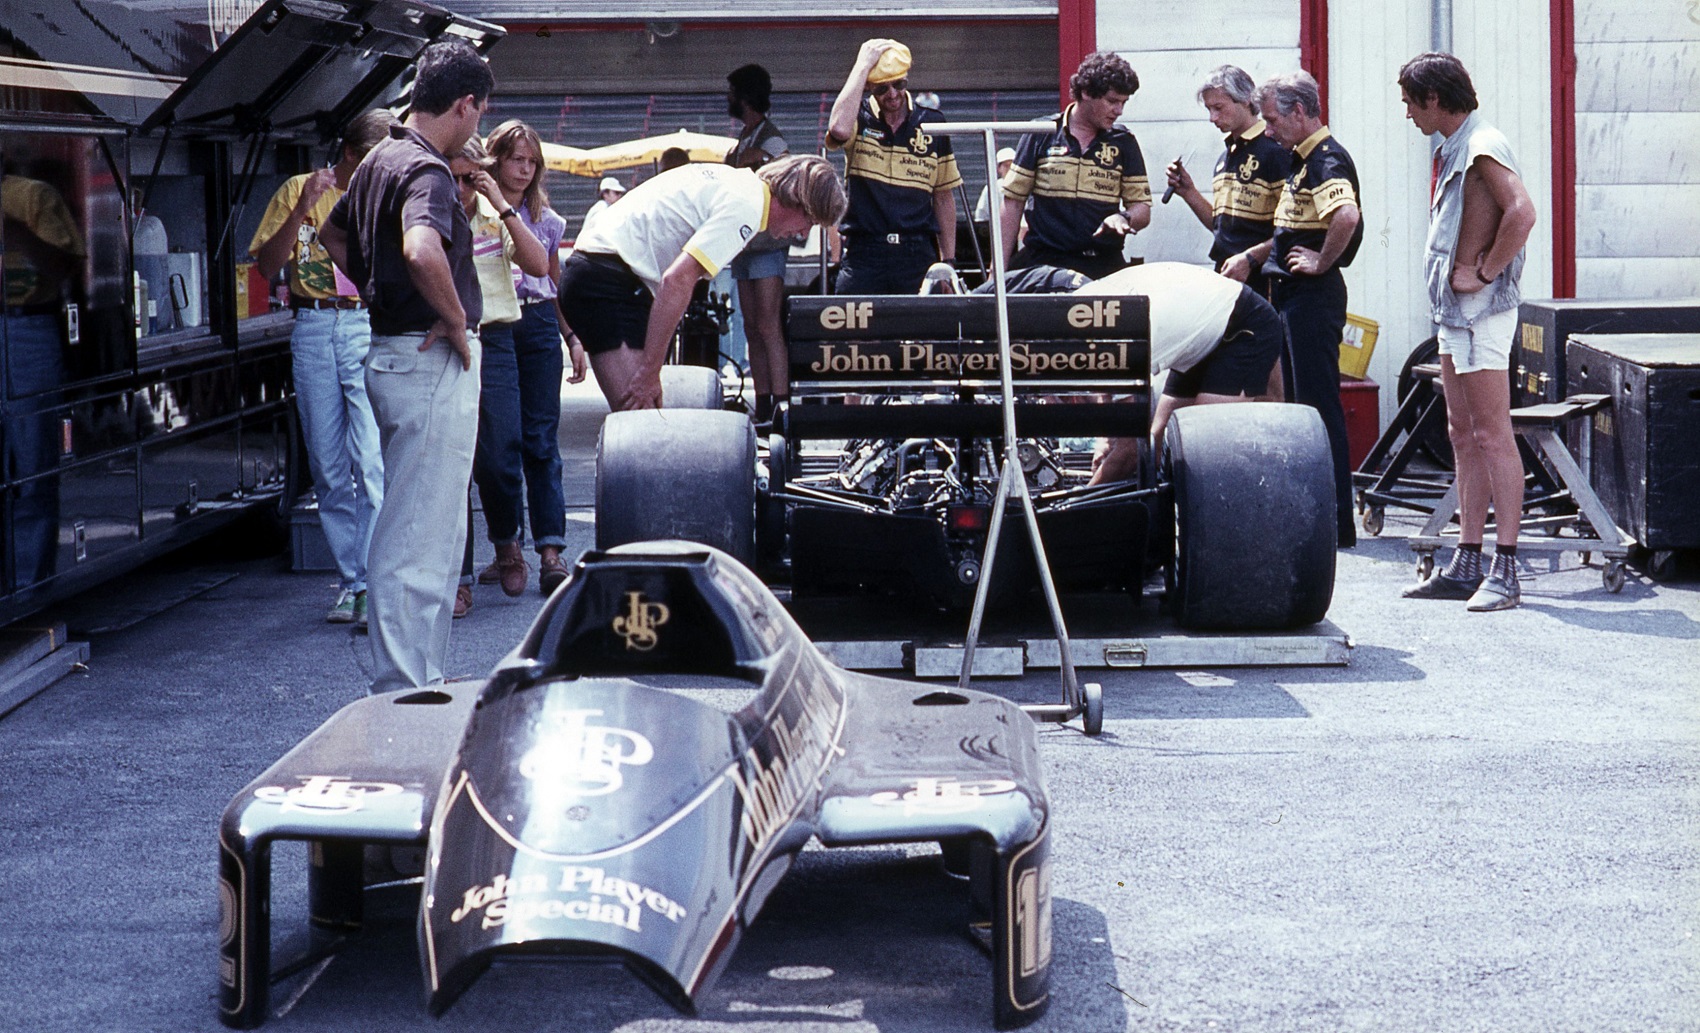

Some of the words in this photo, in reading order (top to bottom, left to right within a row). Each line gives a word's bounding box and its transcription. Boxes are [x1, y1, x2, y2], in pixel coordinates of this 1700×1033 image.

[1329, 188, 1344, 199] elf
[819, 301, 874, 330] elf
[1067, 300, 1121, 329] elf
[811, 344, 894, 373] John
[899, 343, 1000, 375] Player
[1009, 343, 1130, 375] Special
[450, 873, 548, 924] John
[557, 865, 688, 924] Player
[481, 895, 643, 934] Special
